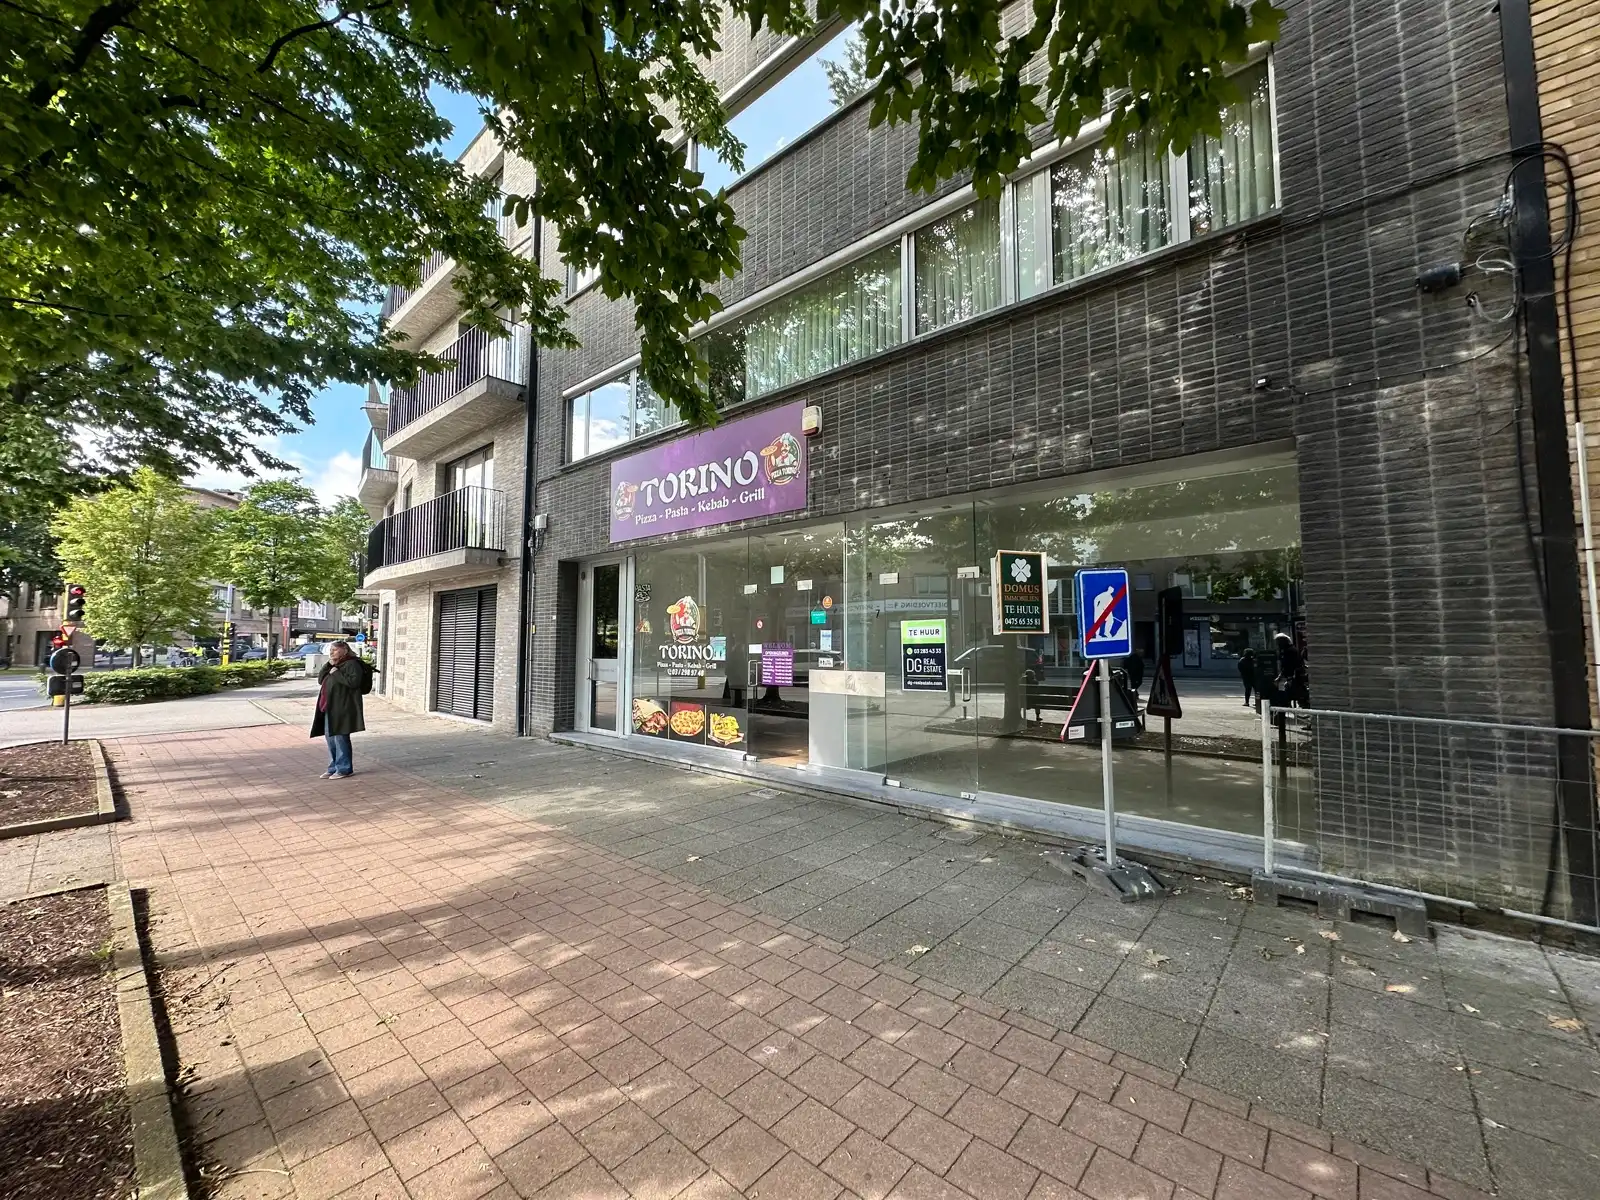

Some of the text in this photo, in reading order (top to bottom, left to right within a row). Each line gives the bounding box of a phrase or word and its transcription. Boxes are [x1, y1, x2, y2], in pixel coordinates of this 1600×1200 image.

[641, 450, 758, 507] TORINO
[635, 514, 657, 525] Pizza
[665, 506, 689, 519] Pasta
[698, 496, 729, 513] Kebab
[740, 487, 765, 504] Grill
[1004, 584, 1040, 593] DOMUS
[1005, 605, 1040, 614] TE HUUR
[1004, 617, 1018, 625] 0475
[658, 644, 714, 660] TORINO
[907, 658, 922, 672] DG
